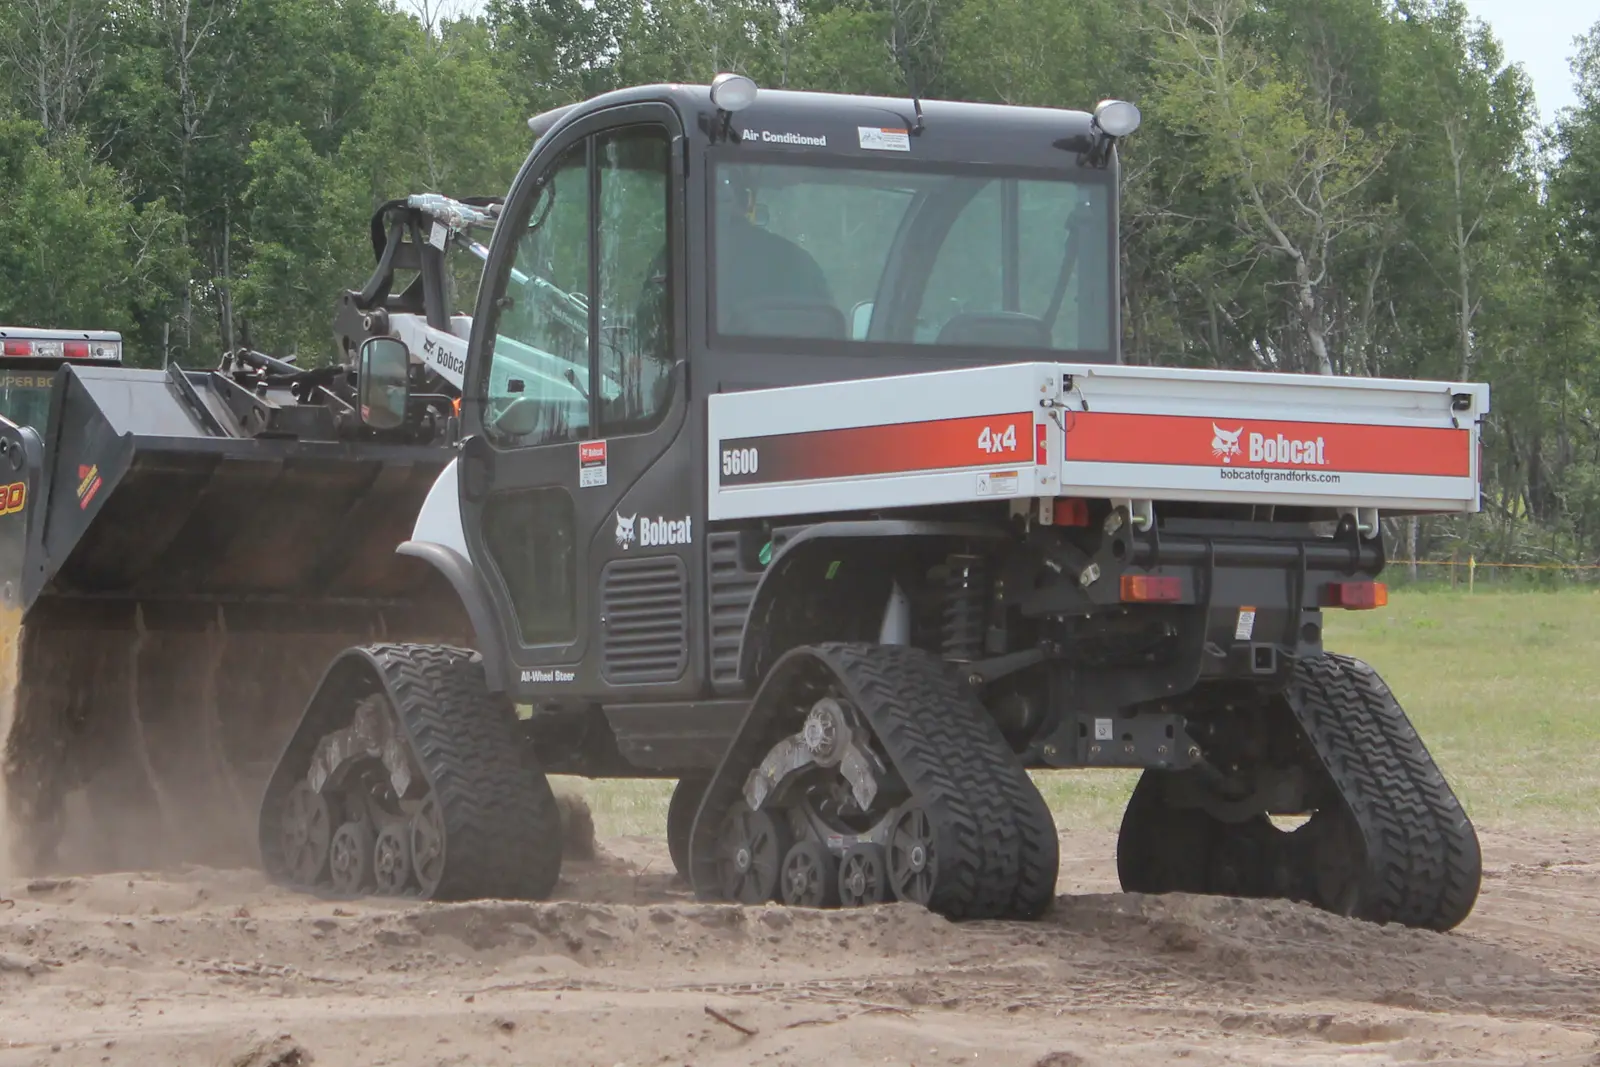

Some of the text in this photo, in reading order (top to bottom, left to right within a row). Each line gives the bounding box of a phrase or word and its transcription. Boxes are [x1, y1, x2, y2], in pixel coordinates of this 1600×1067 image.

[742, 128, 827, 146] Air Conditioned
[437, 346, 465, 375] Bobca
[977, 424, 1017, 453] 4x4
[1249, 432, 1325, 465] Bobcat
[722, 448, 758, 476] 5600
[1220, 468, 1341, 484] bobcatofgrandforks.com
[640, 515, 692, 546] Bobcat
[521, 670, 576, 682] All-Wheel Steer
